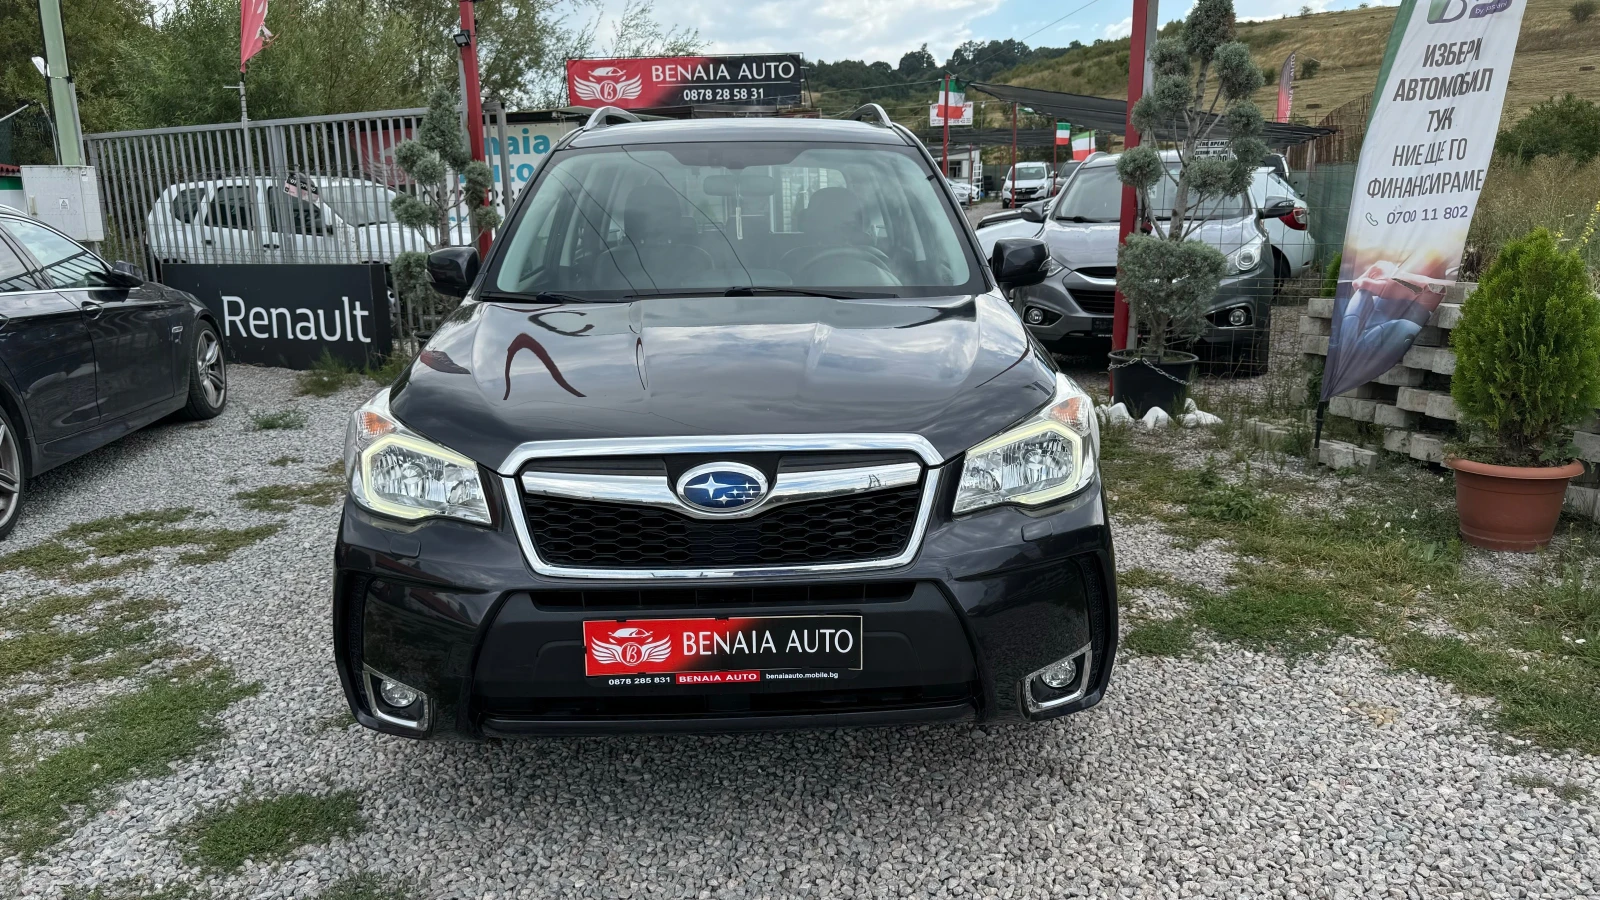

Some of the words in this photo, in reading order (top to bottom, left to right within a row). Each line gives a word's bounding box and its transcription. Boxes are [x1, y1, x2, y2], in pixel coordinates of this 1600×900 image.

[1422, 37, 1483, 67] ИЗБЕРИ
[651, 63, 731, 82] BENAIA
[738, 61, 795, 80] AUTO
[1392, 68, 1494, 101] АВТОМОБИЛ
[683, 89, 713, 101] 0878
[715, 88, 731, 100] 28
[733, 88, 748, 100] 58
[750, 87, 764, 99] 31
[1426, 106, 1455, 133] ТУК
[1391, 144, 1425, 167] НИЕ
[1424, 140, 1447, 166] ЩЕ
[1448, 138, 1468, 161] ГО
[1367, 169, 1484, 198] ФИНАНСИРАМЕ
[1386, 210, 1417, 225] 0700
[1421, 208, 1438, 221] 11
[1443, 205, 1468, 219] 802
[221, 296, 371, 343] Renault
[683, 630, 776, 656] BENAIA
[786, 629, 853, 653] AUTO
[634, 677, 652, 685] 285
[679, 674, 722, 683] BENAIA
[726, 673, 757, 681] AUTO
[766, 671, 839, 680] benaiaauto.mobile.bg
